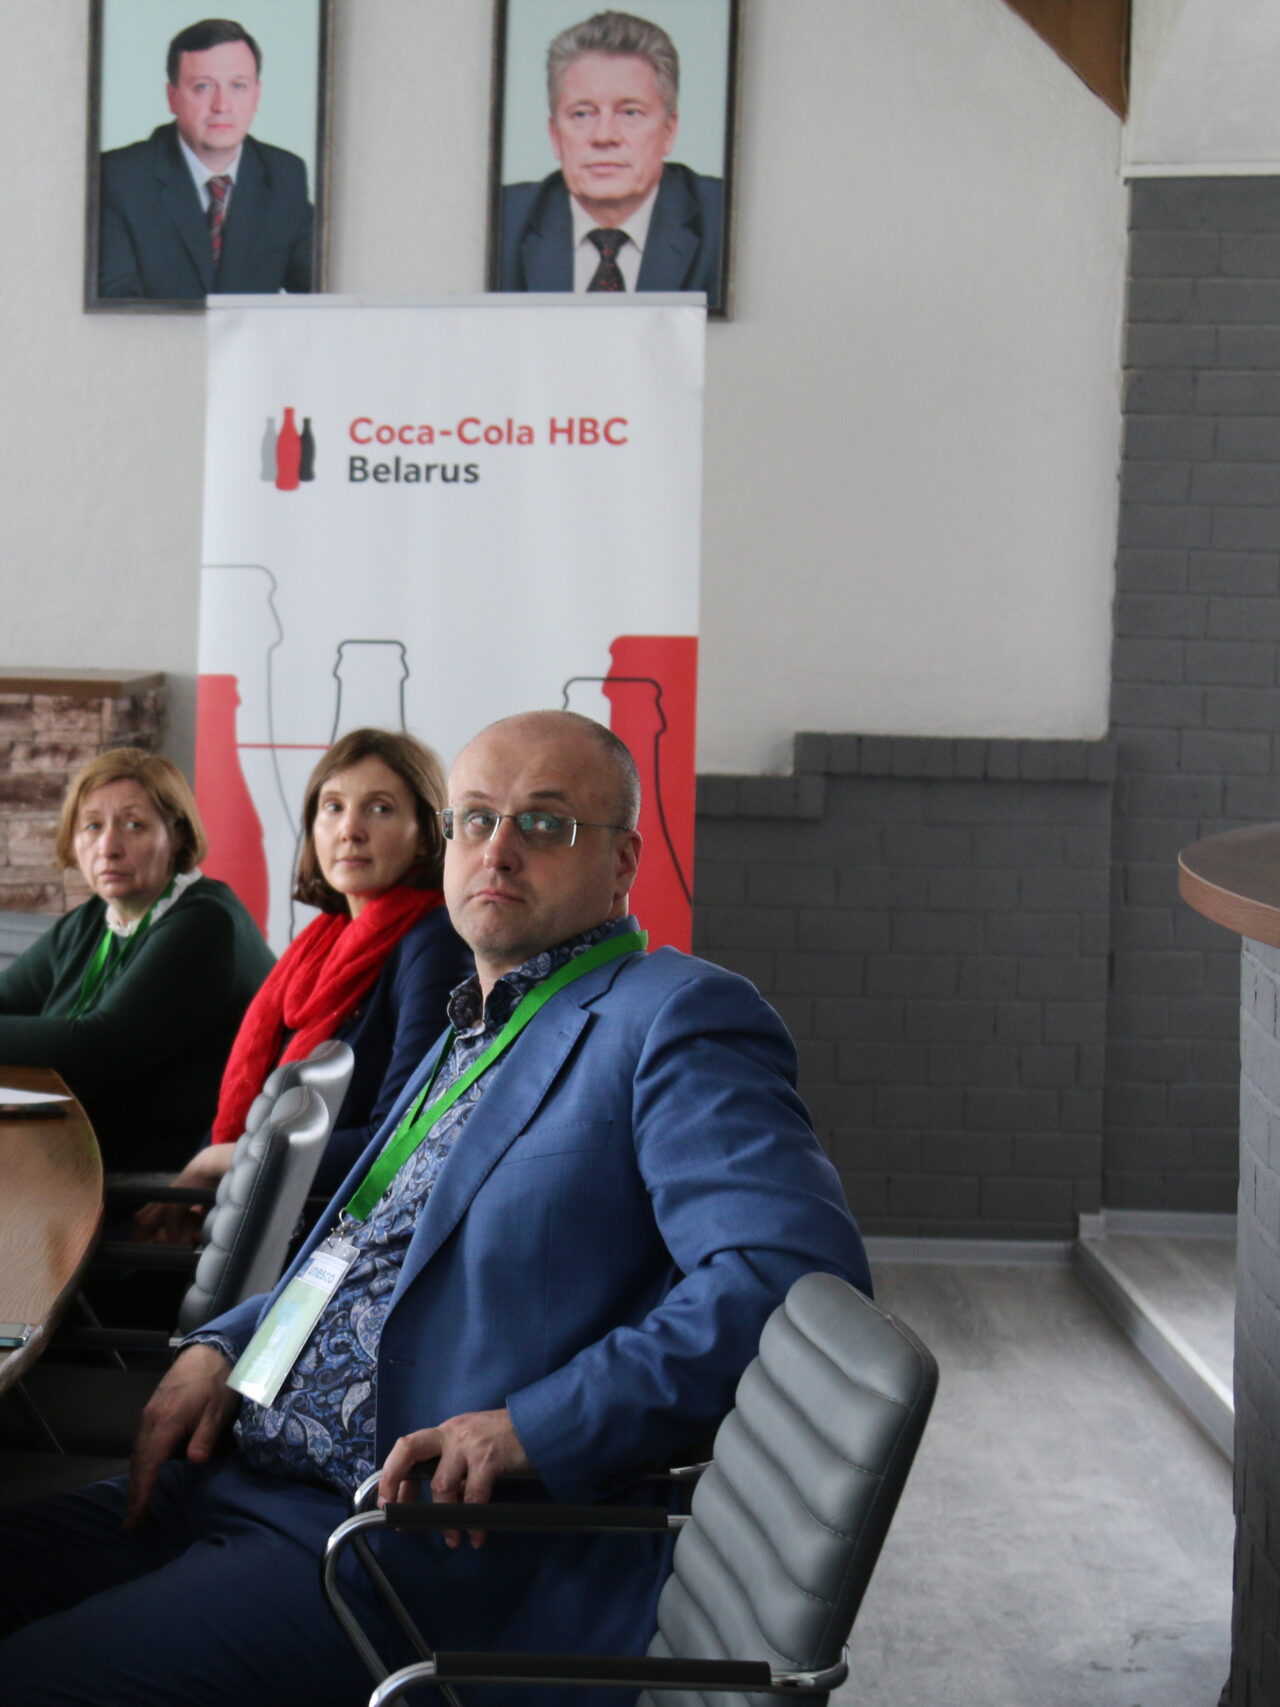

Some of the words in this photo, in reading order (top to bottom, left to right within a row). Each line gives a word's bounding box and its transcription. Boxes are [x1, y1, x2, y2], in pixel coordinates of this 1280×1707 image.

[348, 417, 535, 446] Coca-Cola
[549, 417, 629, 446] HBC
[348, 456, 480, 484] Belarus
